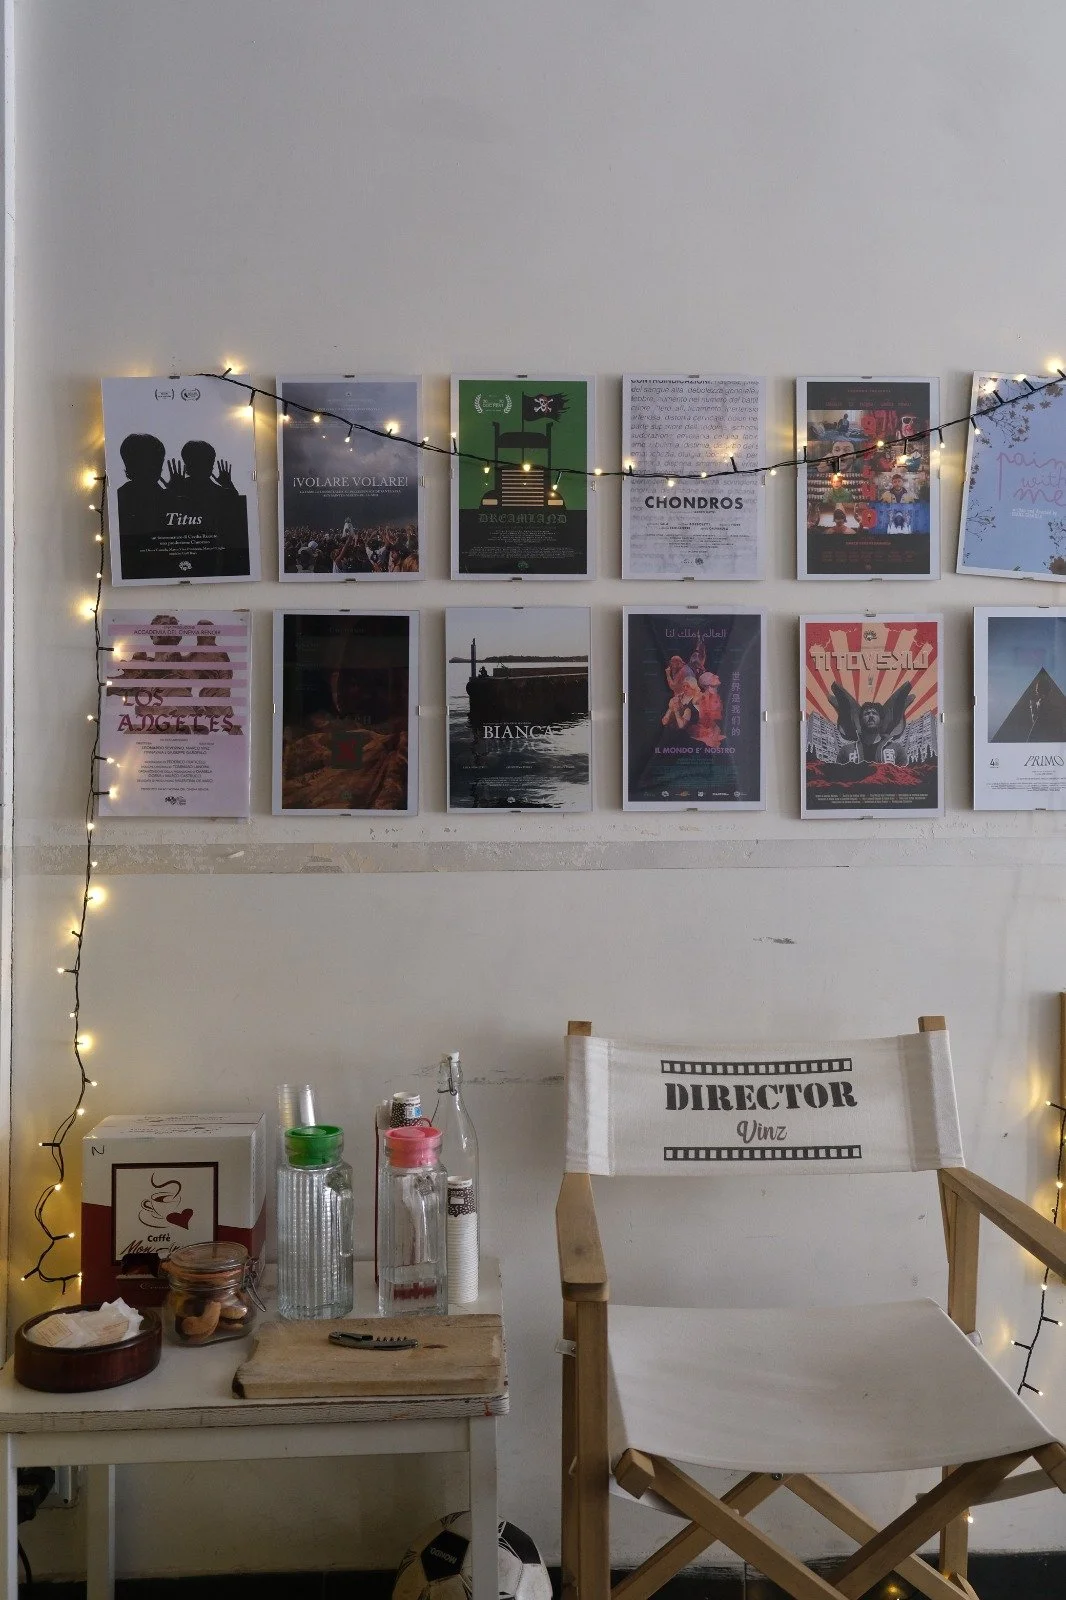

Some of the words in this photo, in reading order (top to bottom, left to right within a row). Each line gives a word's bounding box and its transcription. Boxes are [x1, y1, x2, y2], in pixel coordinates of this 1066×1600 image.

[293, 477, 350, 488] ¡VOLARE
[352, 477, 408, 488] VOLARE!
[644, 495, 744, 510] CHONDROS
[1013, 488, 1066, 507] me
[166, 512, 203, 526] Titus
[478, 513, 568, 524] DREAMLAND
[123, 689, 164, 707] LOS
[116, 713, 234, 732] ANGELES
[483, 725, 554, 739] BIANCA
[704, 747, 736, 755] NOSTRO
[1023, 755, 1065, 767] PRIMO
[664, 1081, 858, 1111] DIRECTOR
[736, 1120, 788, 1144] Vinz
[147, 1233, 171, 1242] Caffè
